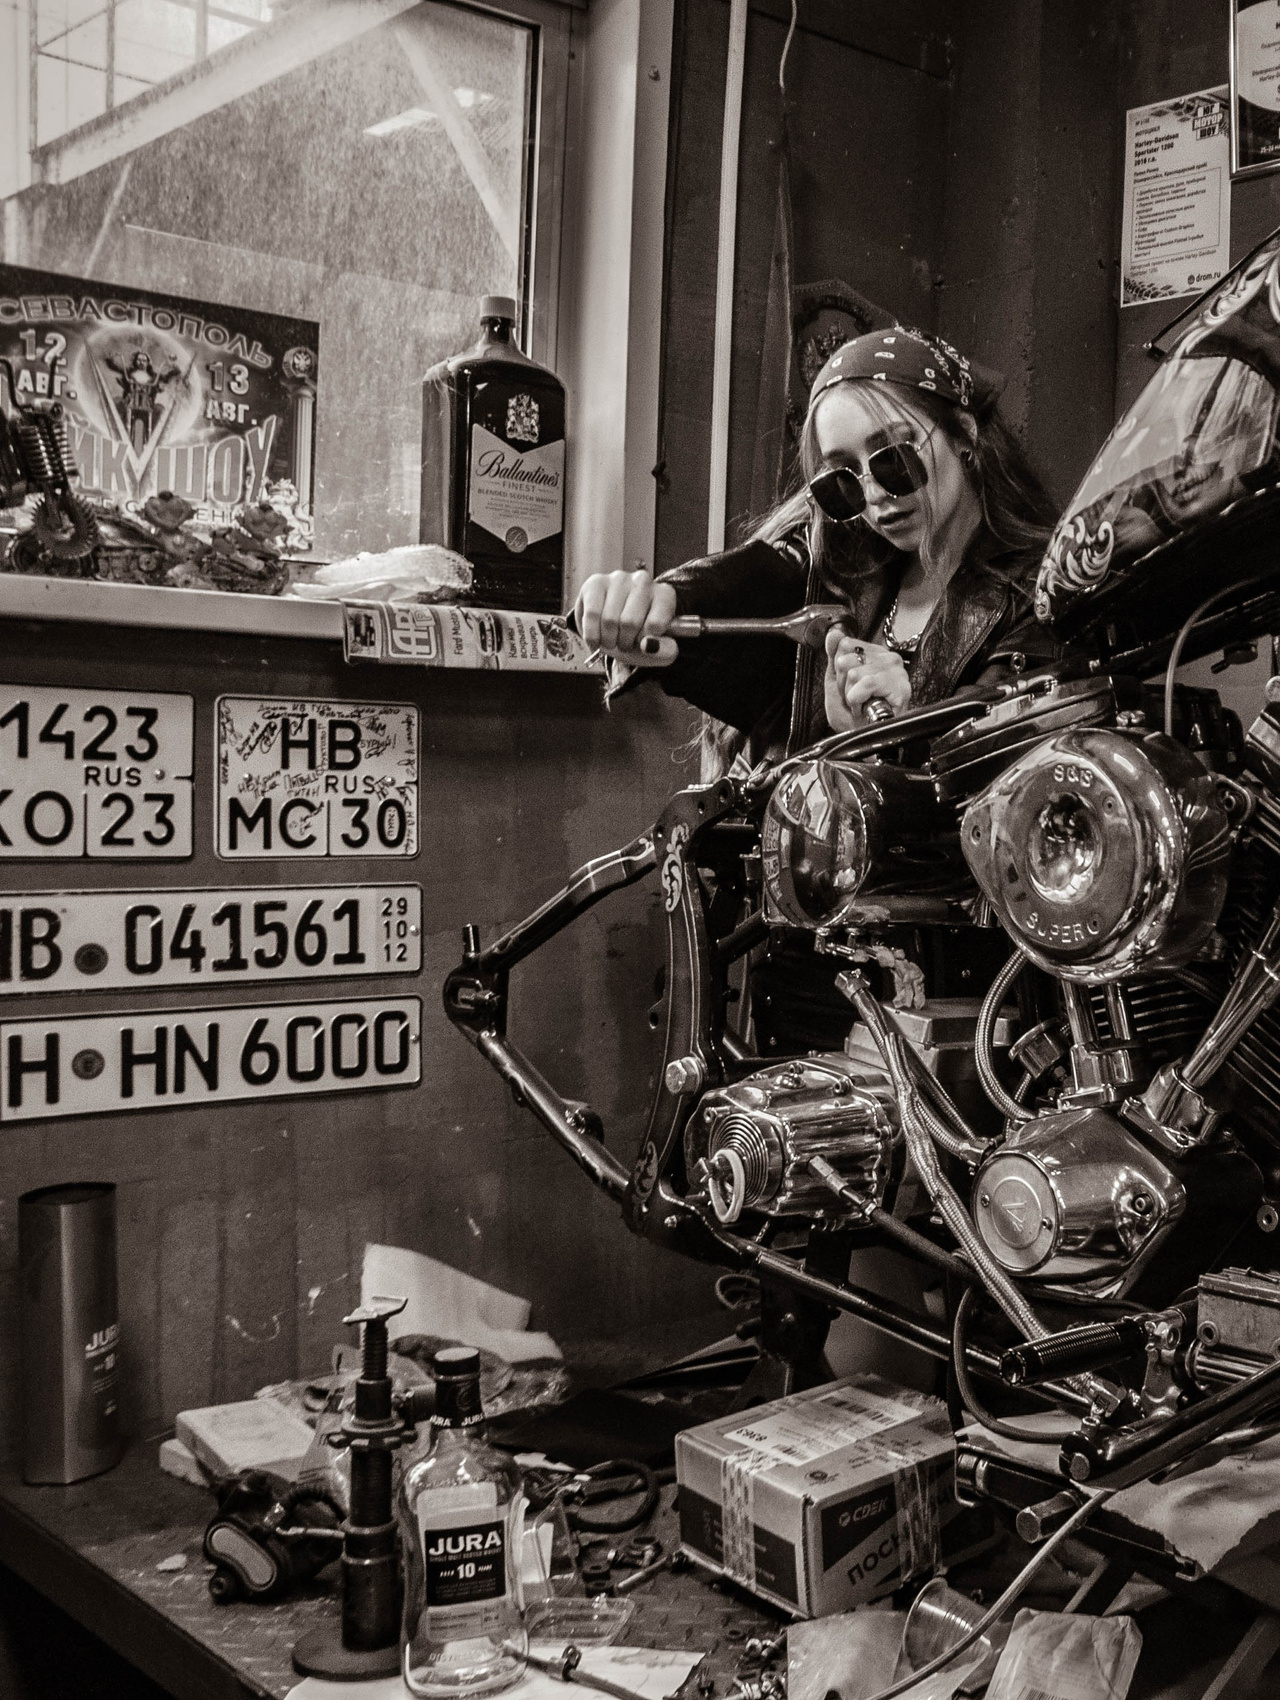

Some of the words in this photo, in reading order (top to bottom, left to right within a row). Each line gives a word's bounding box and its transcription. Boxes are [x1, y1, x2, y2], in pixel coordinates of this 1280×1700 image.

[1135, 133, 1179, 149] Harley-Davidson
[1135, 146, 1159, 158] Sportster
[1161, 142, 1174, 151] 1200
[1196, 271, 1221, 283] drom.ru
[0, 295, 273, 369] СЕВАСТОПОЛЬ
[19, 328, 67, 366] 12
[207, 361, 249, 395] 13
[205, 399, 258, 424] АВГ.
[475, 449, 560, 487] Ballantine's
[477, 488, 508, 498] BLENDED
[509, 492, 534, 501] SCOTCH
[502, 481, 536, 493] FINEST
[452, 637, 464, 656] Ford
[85, 765, 141, 787] RUS
[325, 774, 376, 794] RUS
[1053, 764, 1094, 788] S&S
[101, 793, 174, 846] 23
[341, 798, 406, 849] 30
[381, 897, 408, 917] 29
[0, 907, 62, 982] B
[125, 899, 366, 975] 041561
[382, 919, 408, 940] 10
[382, 942, 408, 962] 12
[8, 1032, 60, 1107] H
[120, 1022, 219, 1098] HN
[240, 1010, 409, 1086] 6000
[85, 1324, 120, 1352] JUR
[428, 1530, 502, 1556] JURA
[457, 1562, 476, 1579] 10
